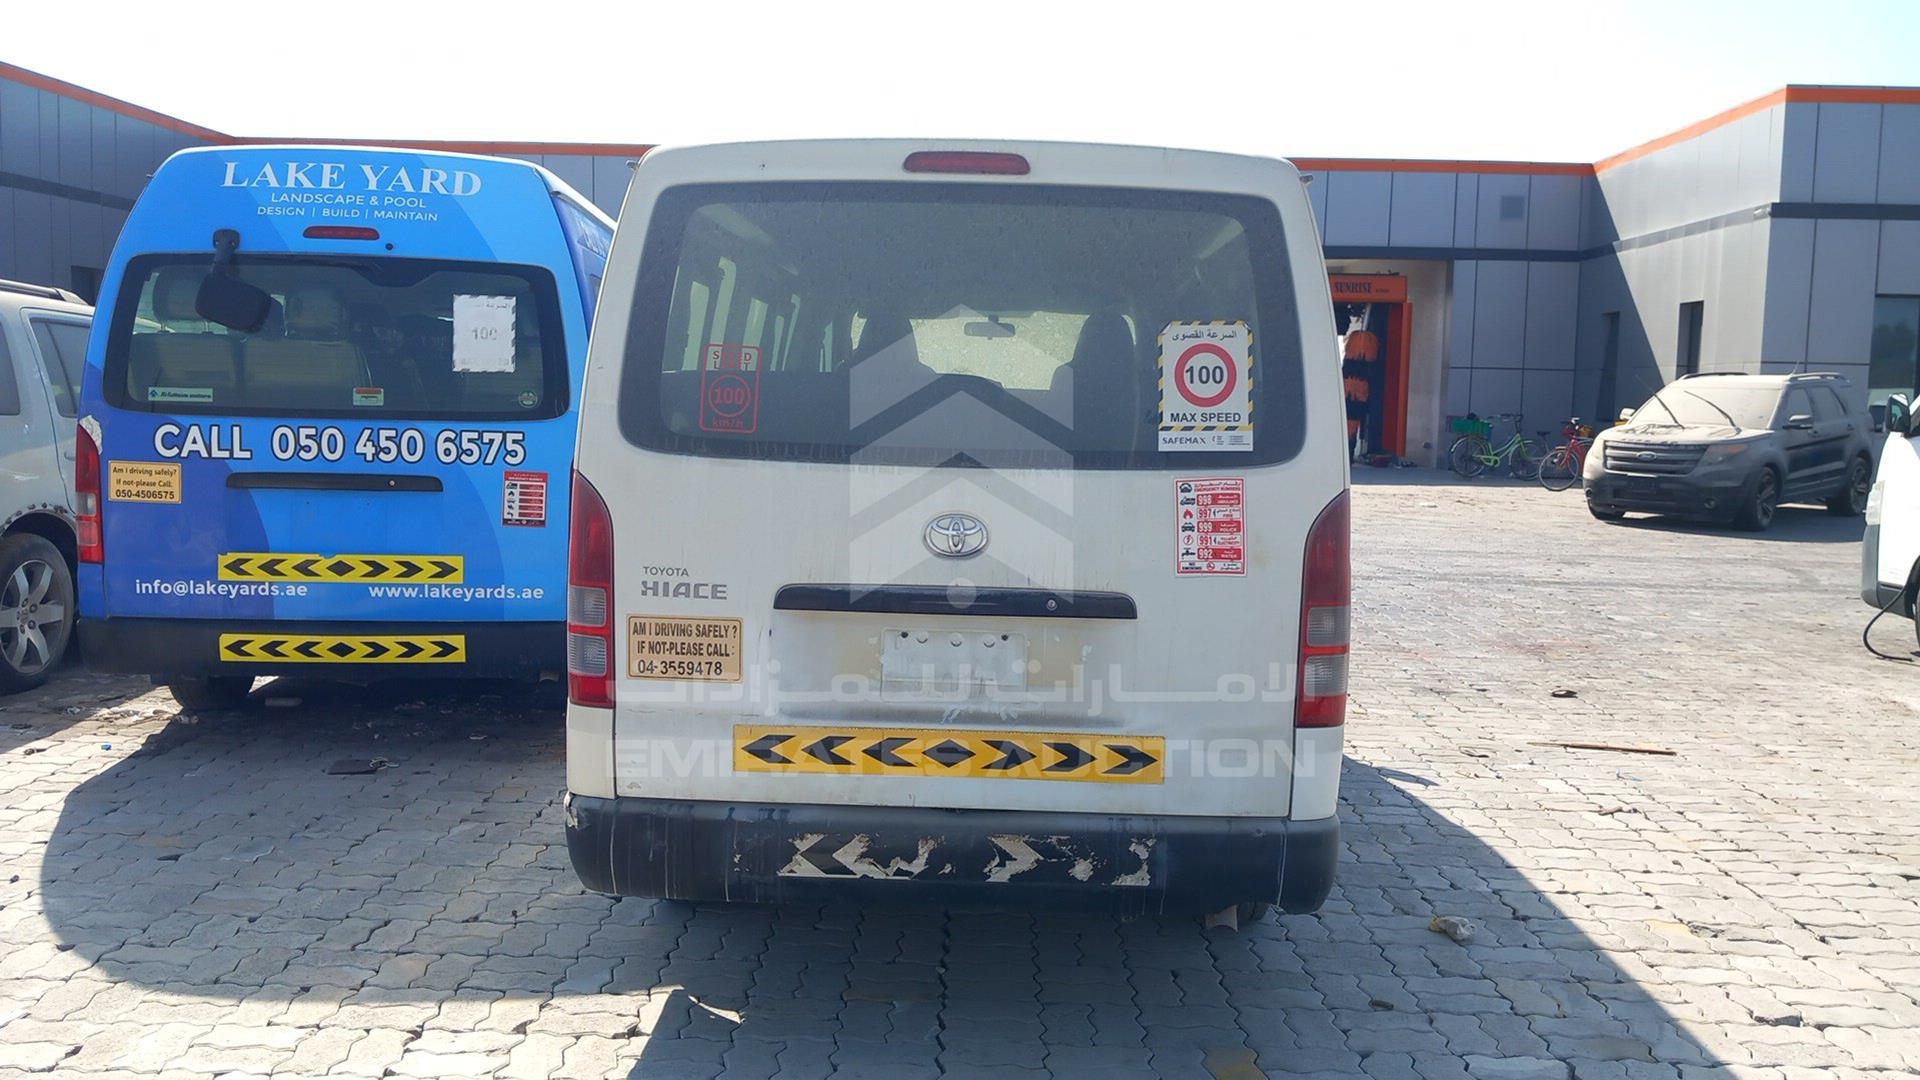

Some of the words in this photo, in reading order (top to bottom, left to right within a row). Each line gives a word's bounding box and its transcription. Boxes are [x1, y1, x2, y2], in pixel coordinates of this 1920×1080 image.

[220, 161, 346, 190] LAKE
[359, 164, 482, 197] YARD
[271, 192, 364, 206] LANDSCAPE
[370, 196, 380, 206] &
[384, 196, 427, 208] POOL
[257, 206, 305, 217] DESIGN
[322, 208, 360, 218] BUILD
[374, 211, 438, 222] MAINTAIN
[1185, 365, 1224, 385] 100
[1170, 412, 1197, 422] MAX
[1200, 412, 1242, 423] SPEED
[153, 423, 252, 460] CALL
[270, 425, 346, 462] 050
[354, 427, 425, 464] 450
[434, 429, 526, 466] 6575
[1162, 436, 1206, 444] SAFEMAX
[129, 467, 152, 476] driving
[116, 489, 174, 500] 050-4506575
[1198, 522, 1212, 532] 999
[1198, 549, 1212, 558] 992
[643, 566, 690, 577] TOYOTA
[135, 579, 308, 599] info@lakeyards.ae
[368, 583, 544, 601] www.lakeyards.ae
[641, 580, 728, 600] HIACE
[632, 622, 646, 636] AM
[648, 622, 652, 636] I
[654, 622, 692, 638] DRIVING
[637, 640, 646, 654] IF
[648, 641, 704, 656] NOT-PLEASE
